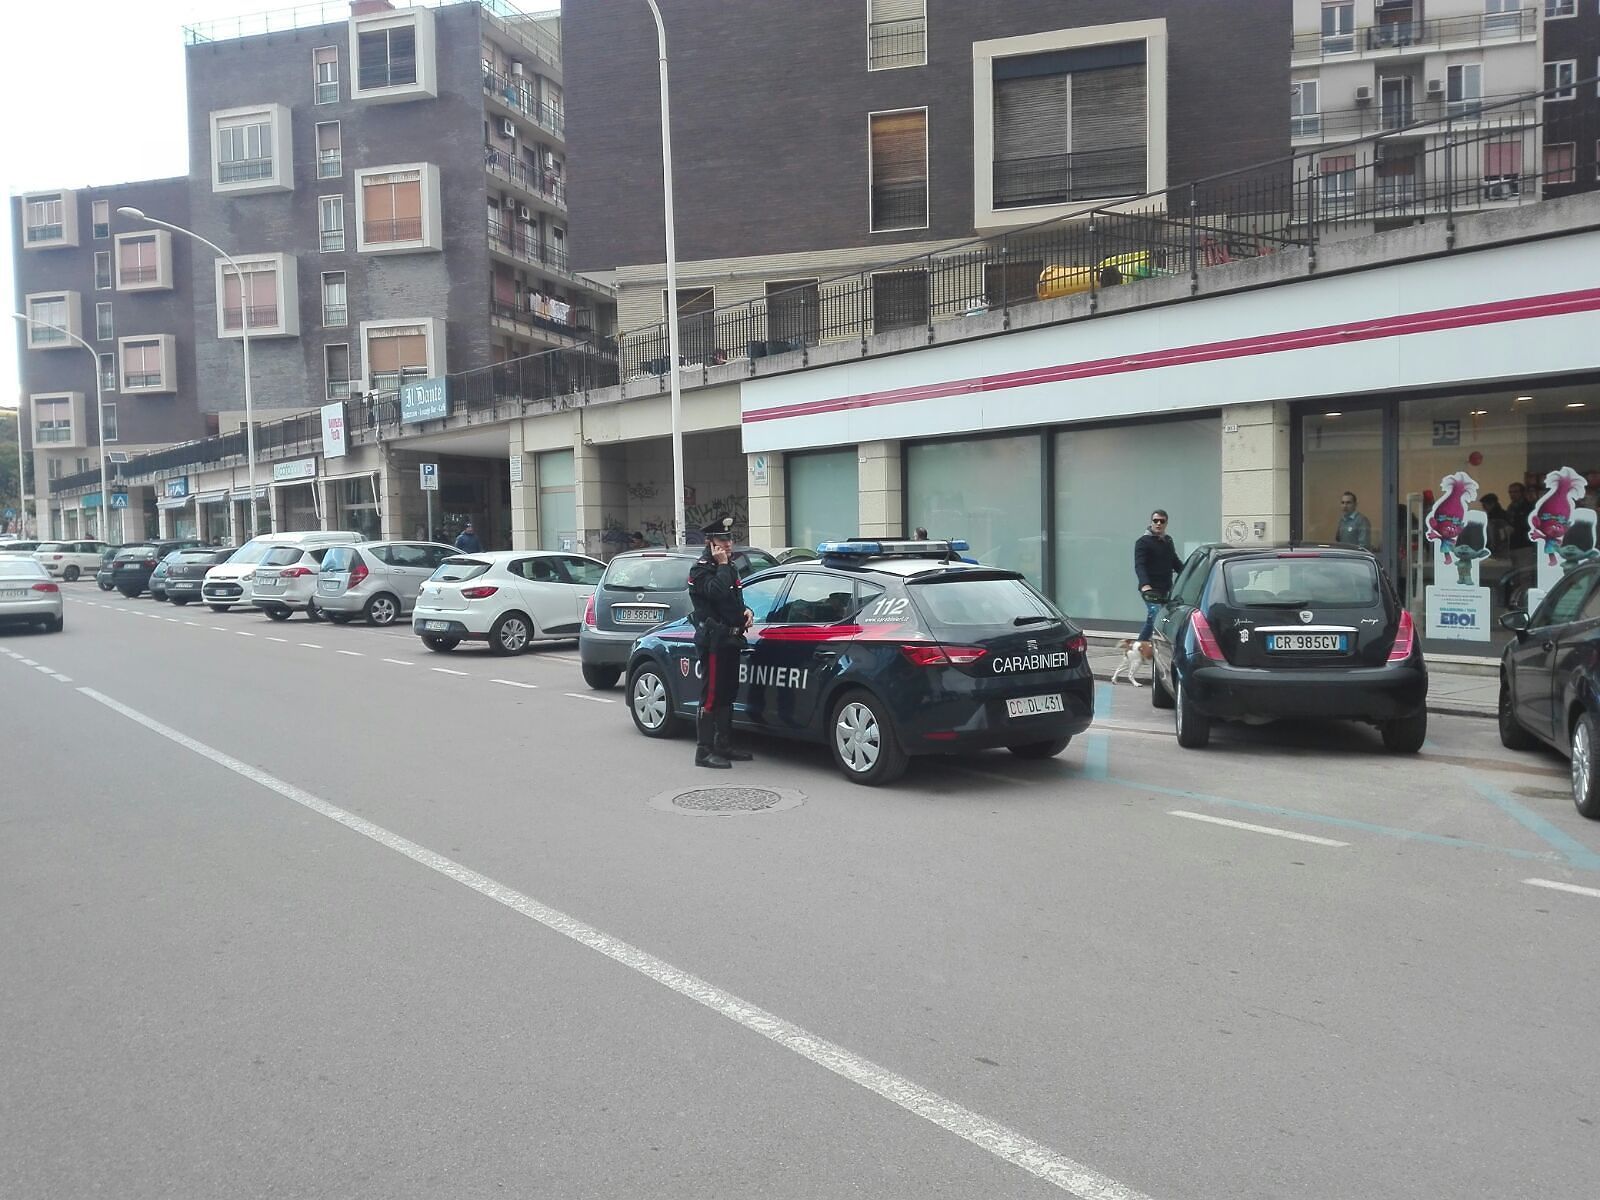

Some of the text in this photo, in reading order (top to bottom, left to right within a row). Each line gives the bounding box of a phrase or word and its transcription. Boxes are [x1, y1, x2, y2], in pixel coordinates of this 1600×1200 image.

[405, 388, 415, 407] Il
[425, 465, 433, 474] P
[873, 597, 909, 616] 112
[1440, 612, 1475, 627] EROI
[1275, 636, 1338, 649] CR 985GV
[992, 651, 1069, 673] CARABINIERI
[695, 659, 808, 689] CBINIERI
[1009, 695, 1062, 716] CC DL 431
